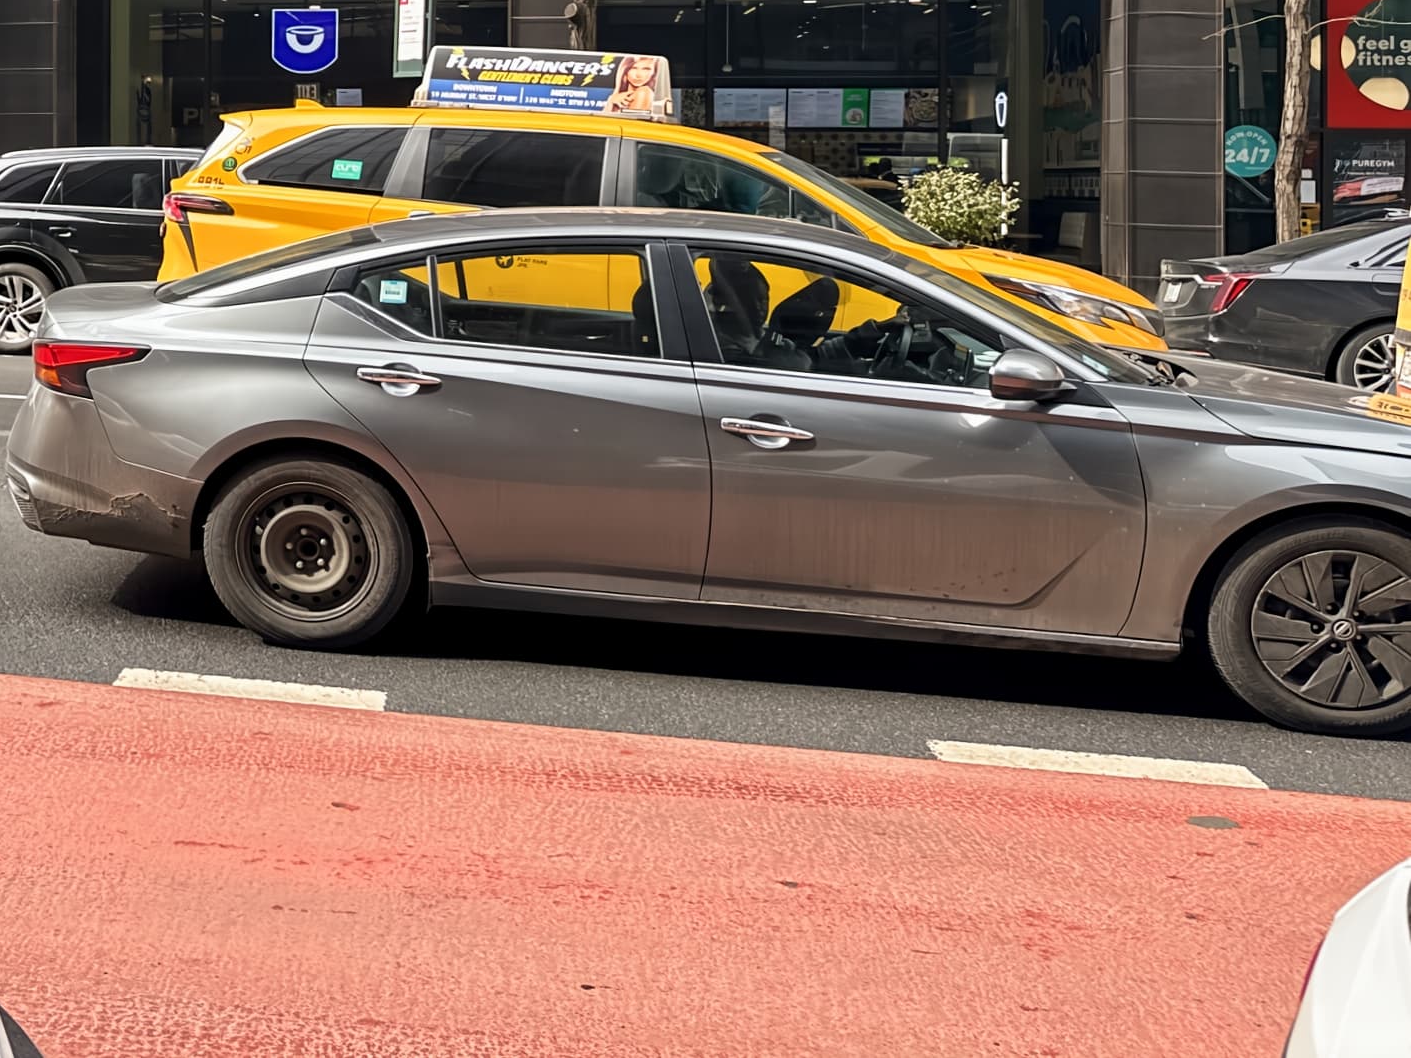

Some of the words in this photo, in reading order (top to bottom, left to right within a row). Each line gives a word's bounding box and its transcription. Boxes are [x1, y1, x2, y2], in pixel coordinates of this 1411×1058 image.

[1357, 35, 1395, 50] feel
[1246, 131, 1268, 145] OPEN
[1225, 146, 1270, 165] 24/7
[1352, 159, 1395, 167] PUREGYM
